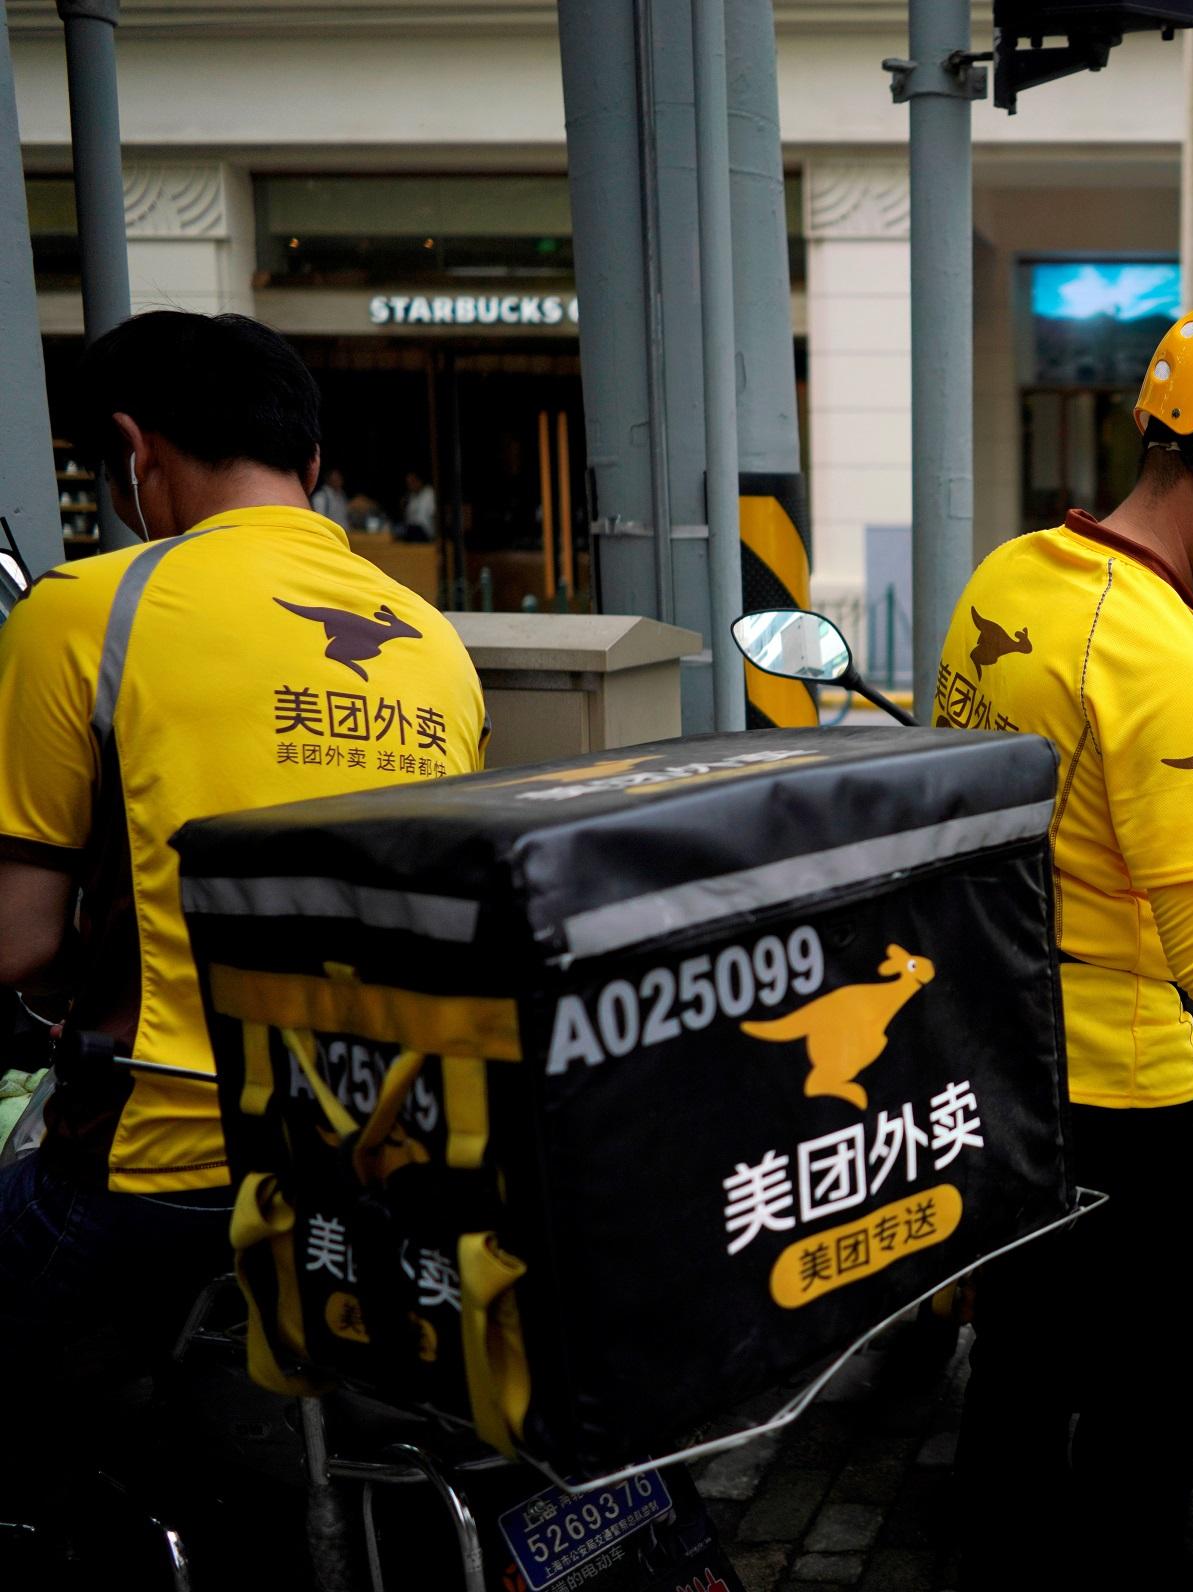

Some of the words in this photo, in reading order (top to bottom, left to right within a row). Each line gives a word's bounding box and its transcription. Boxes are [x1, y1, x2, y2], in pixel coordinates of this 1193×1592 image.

[369, 296, 563, 324] STARBUCKS
[274, 684, 448, 757] 美团外卖
[277, 741, 368, 769] 美团外卖
[376, 750, 448, 780] 送啥都快
[546, 924, 824, 1076] A025099
[723, 1080, 984, 1255] 美团外卖
[799, 1197, 937, 1293] 美团专送
[526, 1471, 653, 1563] 5269376
[544, 1544, 626, 1592] 端的电动车
